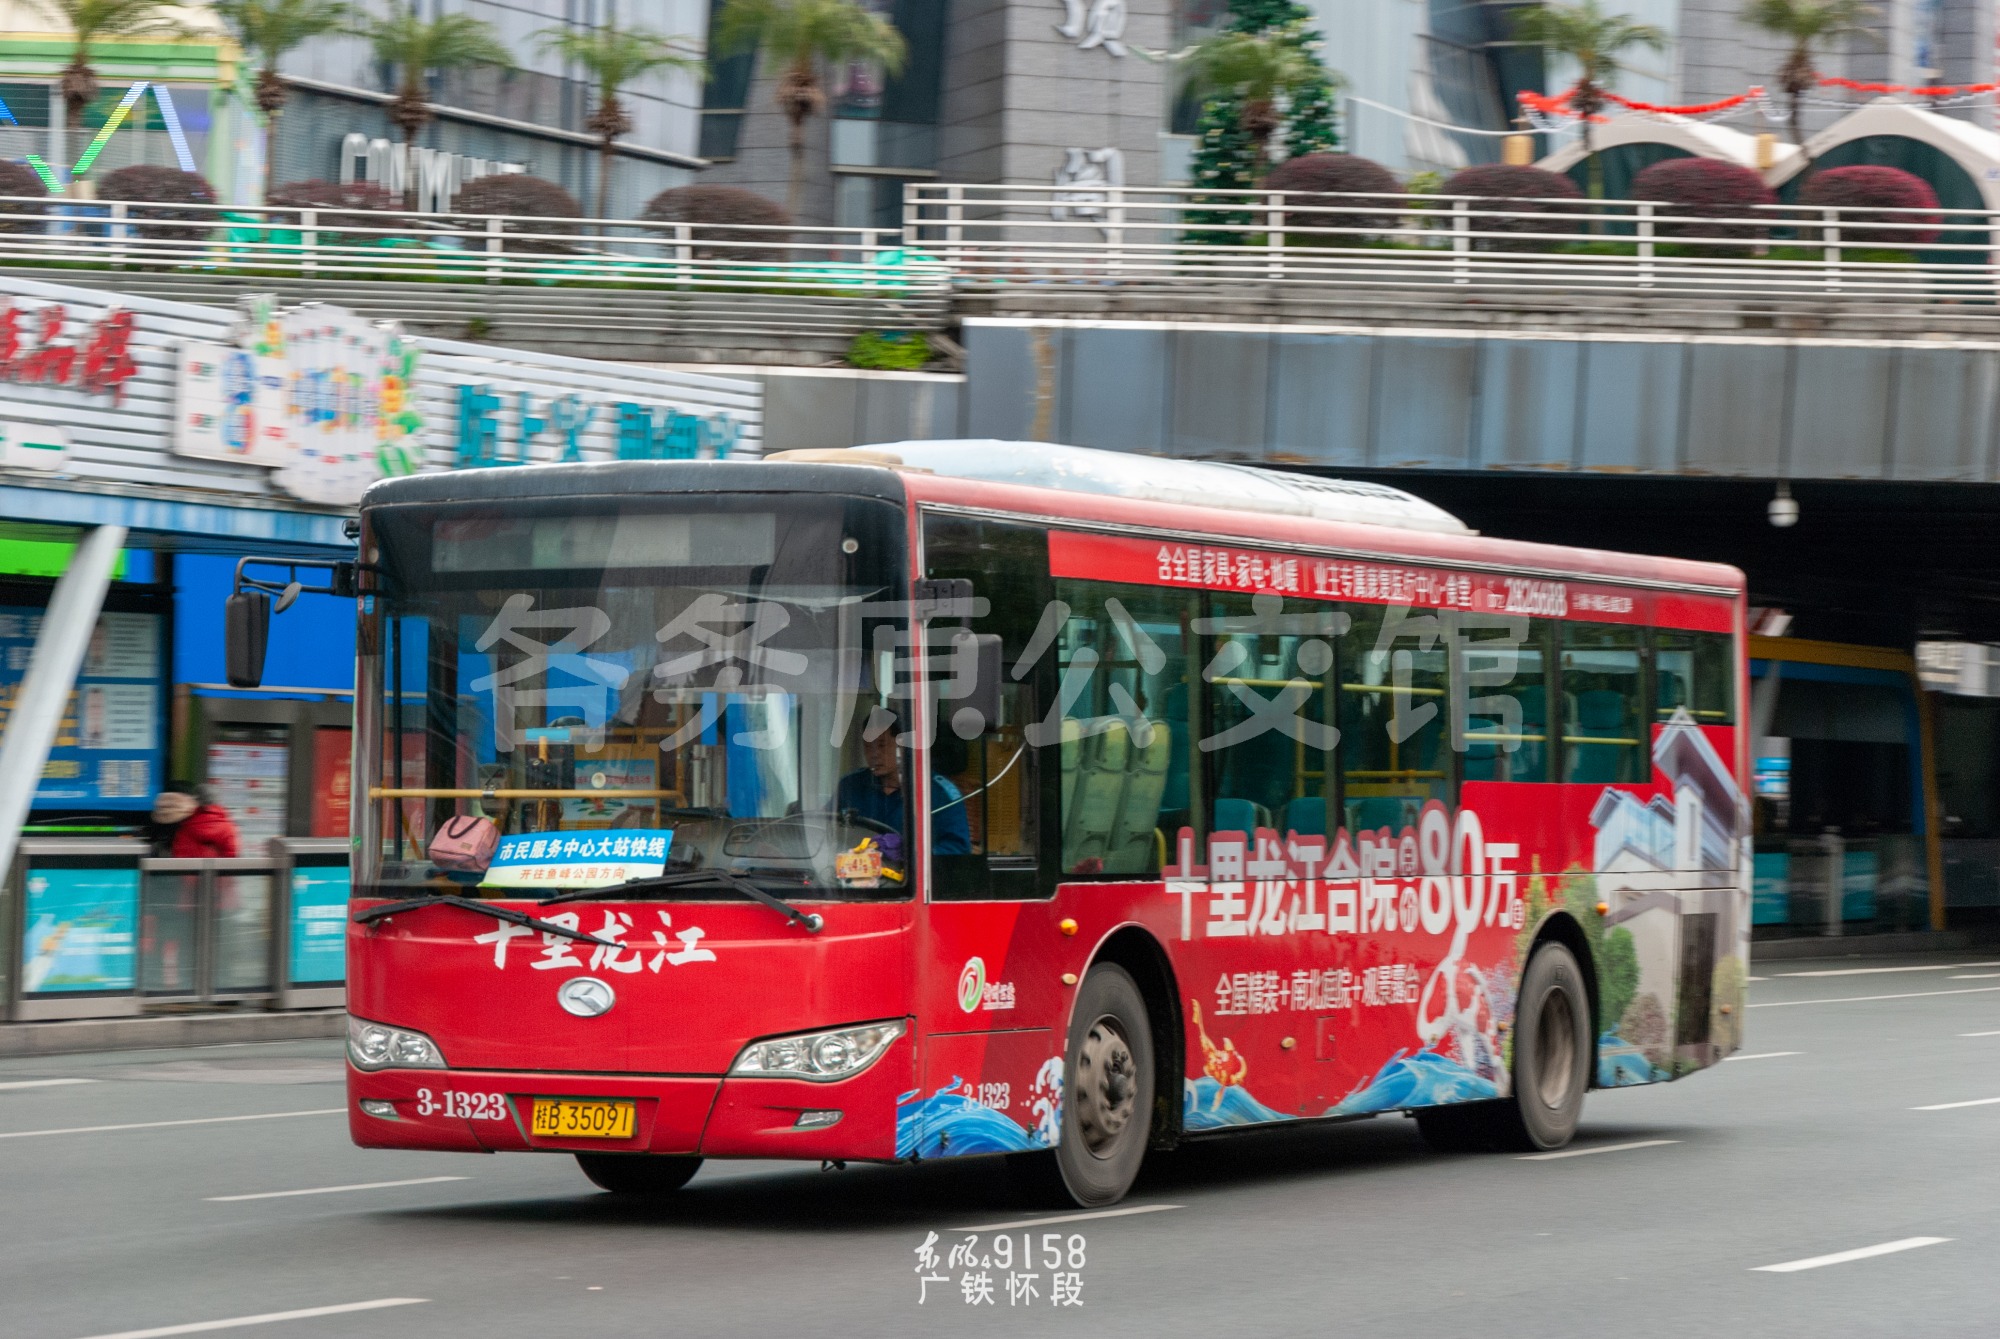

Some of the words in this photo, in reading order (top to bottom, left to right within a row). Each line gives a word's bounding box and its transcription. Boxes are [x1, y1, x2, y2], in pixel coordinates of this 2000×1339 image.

[499, 836, 667, 861] 市民服务中心大站快线
[519, 866, 626, 881] 开往鱼峰公园方向
[1165, 835, 1398, 941] 十里龙江合院
[473, 909, 718, 975] 十里龙江
[416, 1087, 507, 1121] 3-1323
[963, 1082, 1011, 1112] 3-1323
